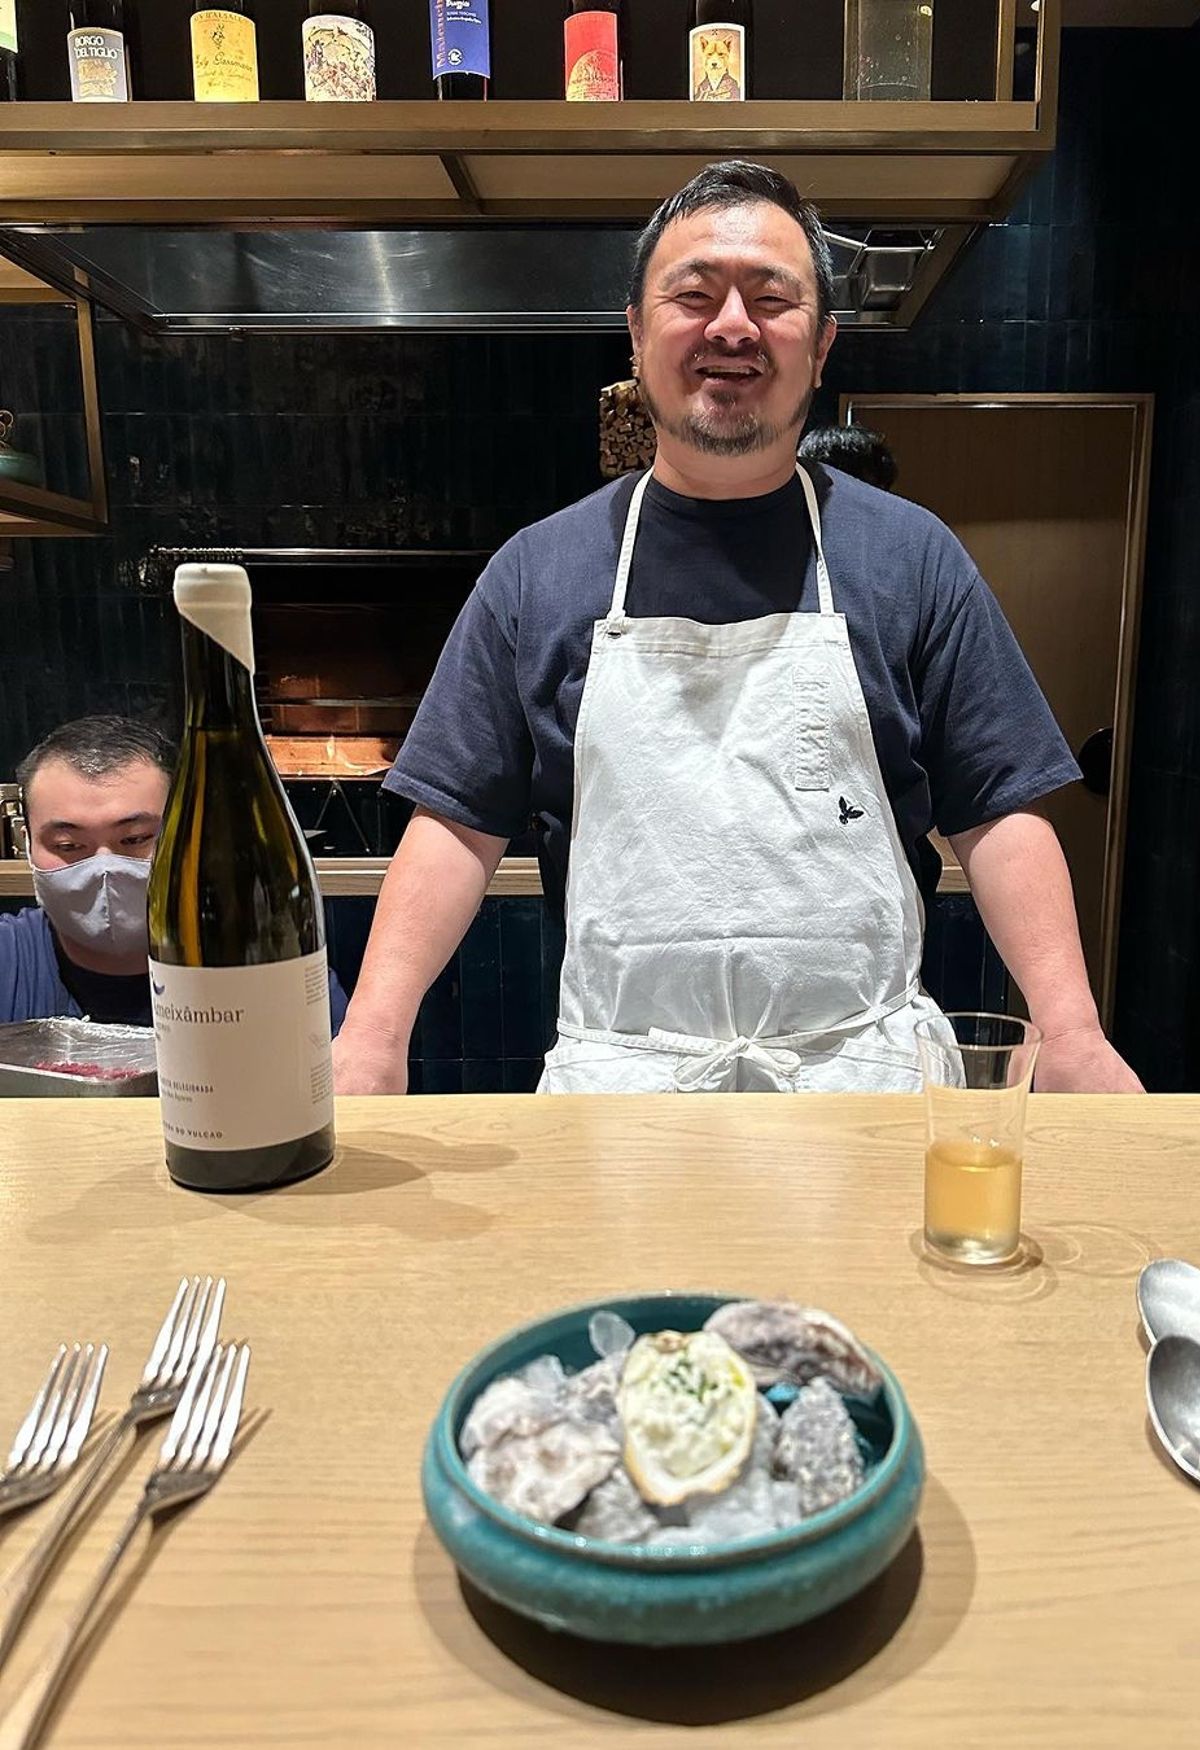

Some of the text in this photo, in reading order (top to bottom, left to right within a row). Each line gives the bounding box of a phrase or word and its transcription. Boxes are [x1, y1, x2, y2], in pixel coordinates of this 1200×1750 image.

[75, 36, 104, 47] BORGO
[88, 47, 118, 59] TIGLIO
[154, 1000, 245, 1023] meixâmbar
